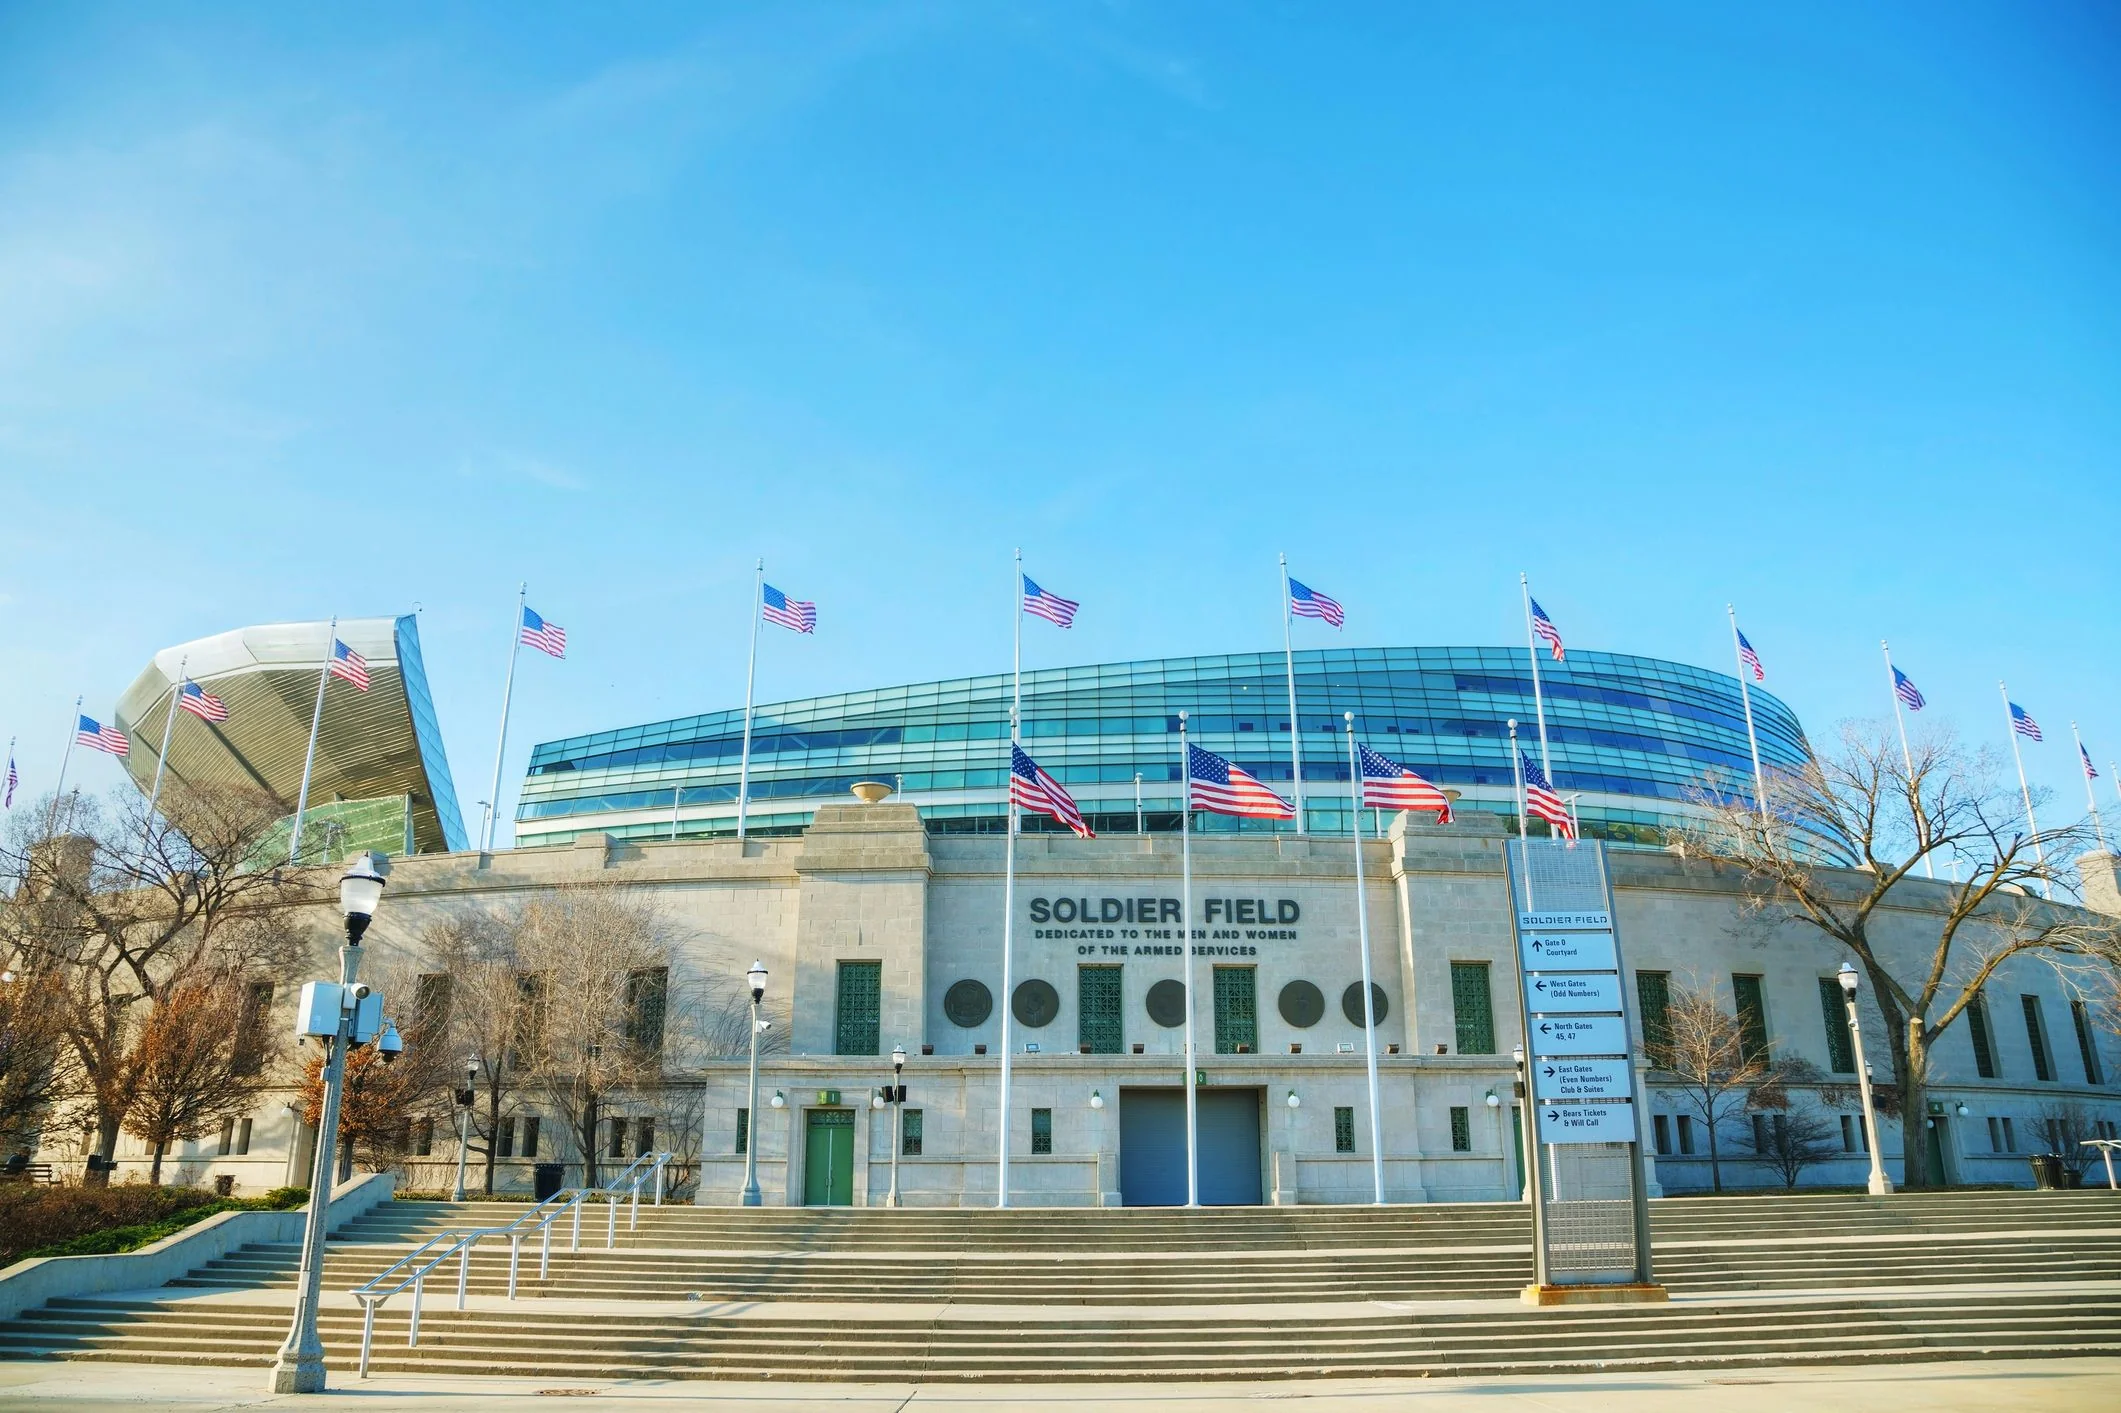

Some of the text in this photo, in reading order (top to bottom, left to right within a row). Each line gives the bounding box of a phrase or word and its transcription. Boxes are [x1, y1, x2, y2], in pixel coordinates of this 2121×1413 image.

[1029, 897, 1300, 924] SOLDIER FIELD
[1522, 916, 1608, 925] SOLDIER FIELD
[1035, 929, 1114, 939] DEDICATED
[1121, 929, 1139, 939] TO
[1145, 929, 1171, 939] THE
[1212, 929, 1240, 940] AND
[1246, 930, 1297, 940] WOMEN
[1077, 946, 1096, 956] OF
[1102, 946, 1128, 956] THE
[1134, 946, 1183, 956] ARMED
[1546, 949, 1577, 957] Courtyard
[1550, 980, 1587, 988] West Gates
[1551, 990, 1600, 999] (Odd Numbers)
[1554, 1022, 1593, 1030] North Gates
[1556, 1033, 1567, 1041] 45,
[1560, 1075, 1612, 1084] (Even Numbers)
[1561, 1086, 1575, 1094] Club
[1584, 1085, 1604, 1093] Suites
[1584, 1109, 1607, 1117] Tickets
[1564, 1119, 1599, 1127] & Will Call
